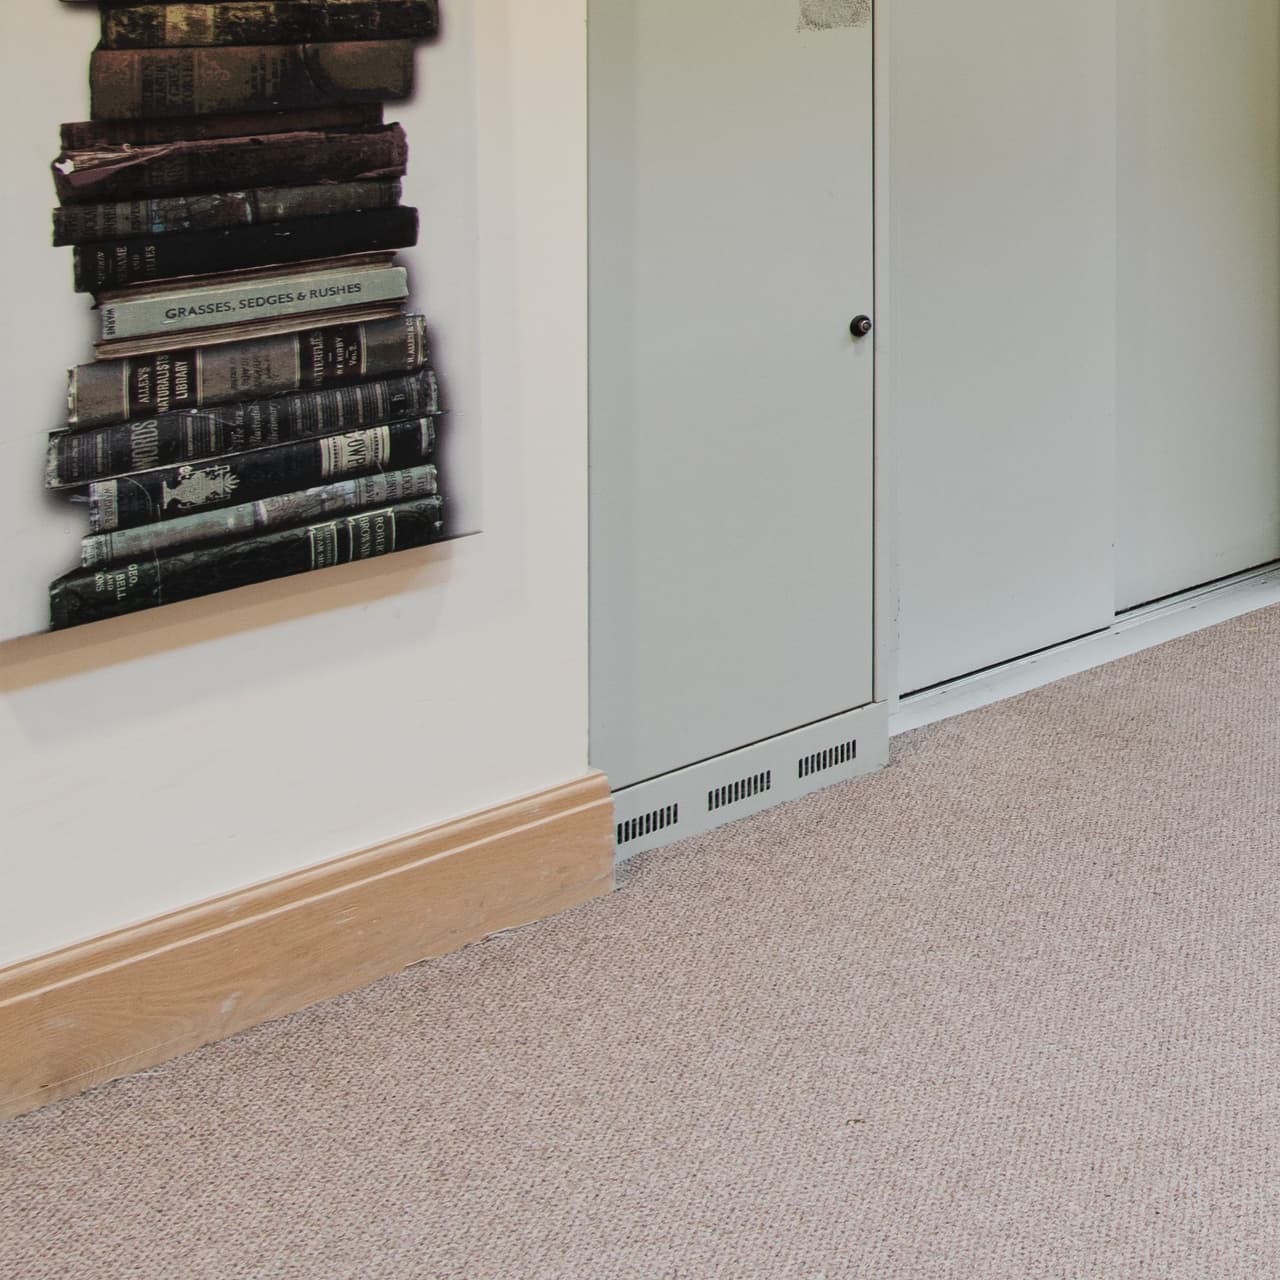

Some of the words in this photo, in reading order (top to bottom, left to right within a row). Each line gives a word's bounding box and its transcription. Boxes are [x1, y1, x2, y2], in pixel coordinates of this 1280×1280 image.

[165, 301, 236, 321] GRASSES,
[239, 292, 294, 310] SEDGES
[297, 291, 307, 301] &
[310, 283, 362, 299] RUSHES
[104, 308, 115, 335] WARNE
[137, 367, 151, 403] ALLEN'S
[174, 361, 188, 399] LIBRARY
[131, 419, 159, 471] WORDS
[115, 574, 127, 600] BELL
[127, 563, 138, 587] GEO.
